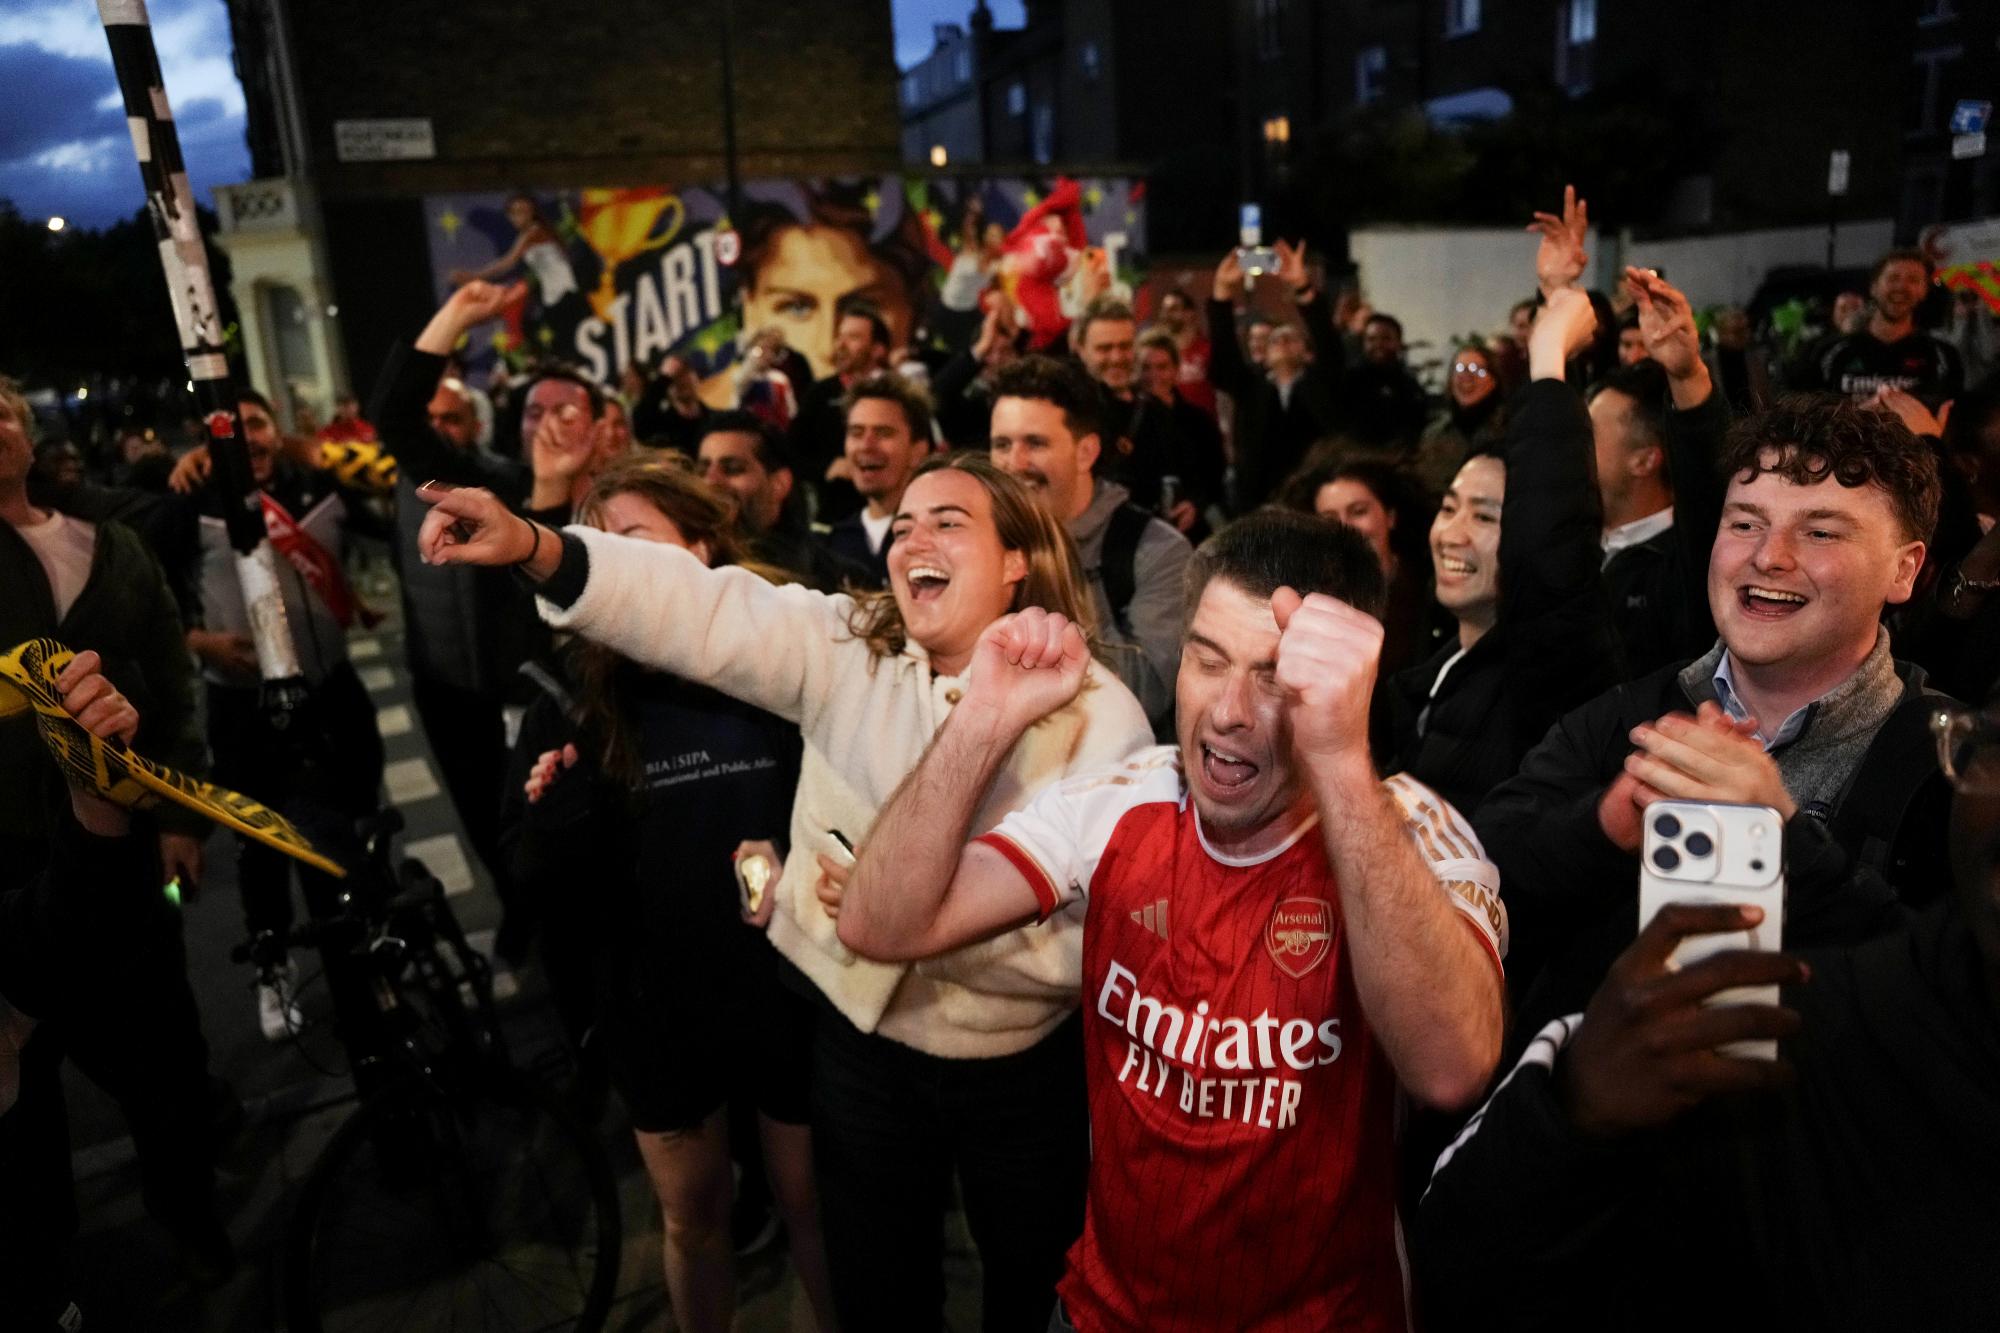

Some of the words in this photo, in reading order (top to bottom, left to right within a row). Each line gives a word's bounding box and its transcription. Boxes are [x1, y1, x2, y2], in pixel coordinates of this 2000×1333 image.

[574, 229, 721, 384] START
[678, 750, 711, 768] SIPA
[1275, 911, 1322, 925] Arsenal
[1097, 959, 1342, 1070] Emirates
[1118, 1041, 1170, 1098] FLY
[1179, 1068, 1302, 1130] BETTER
